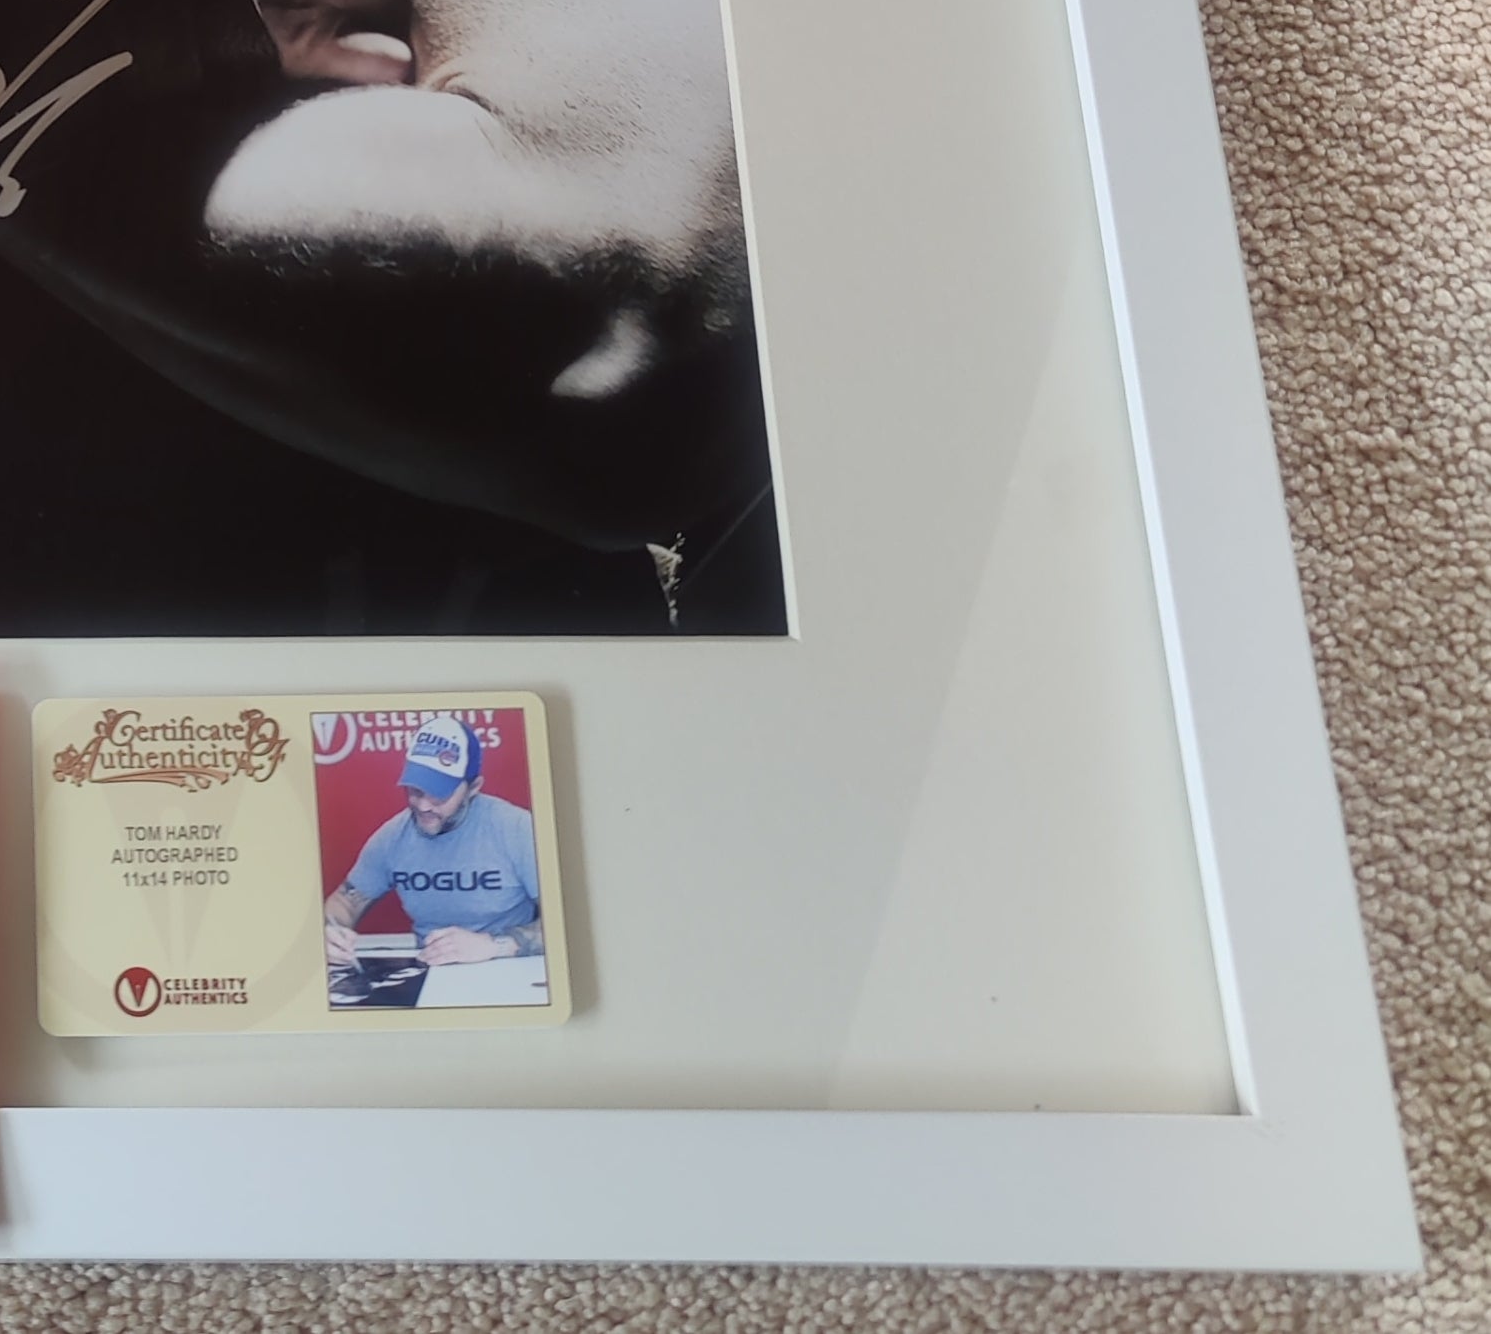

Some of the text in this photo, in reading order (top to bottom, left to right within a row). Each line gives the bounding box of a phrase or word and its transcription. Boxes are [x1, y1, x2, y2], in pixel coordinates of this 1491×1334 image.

[95, 709, 245, 746] Certificate
[53, 736, 253, 786] Authenticity
[125, 824, 222, 841] TOM HARDY
[110, 847, 239, 864] AUTOGRAPHED
[122, 870, 230, 887] 11x14 PHOTO
[392, 870, 503, 892] ROGUE
[163, 977, 247, 991] CELEBRITY
[163, 992, 248, 1005] AUTHENTICS
